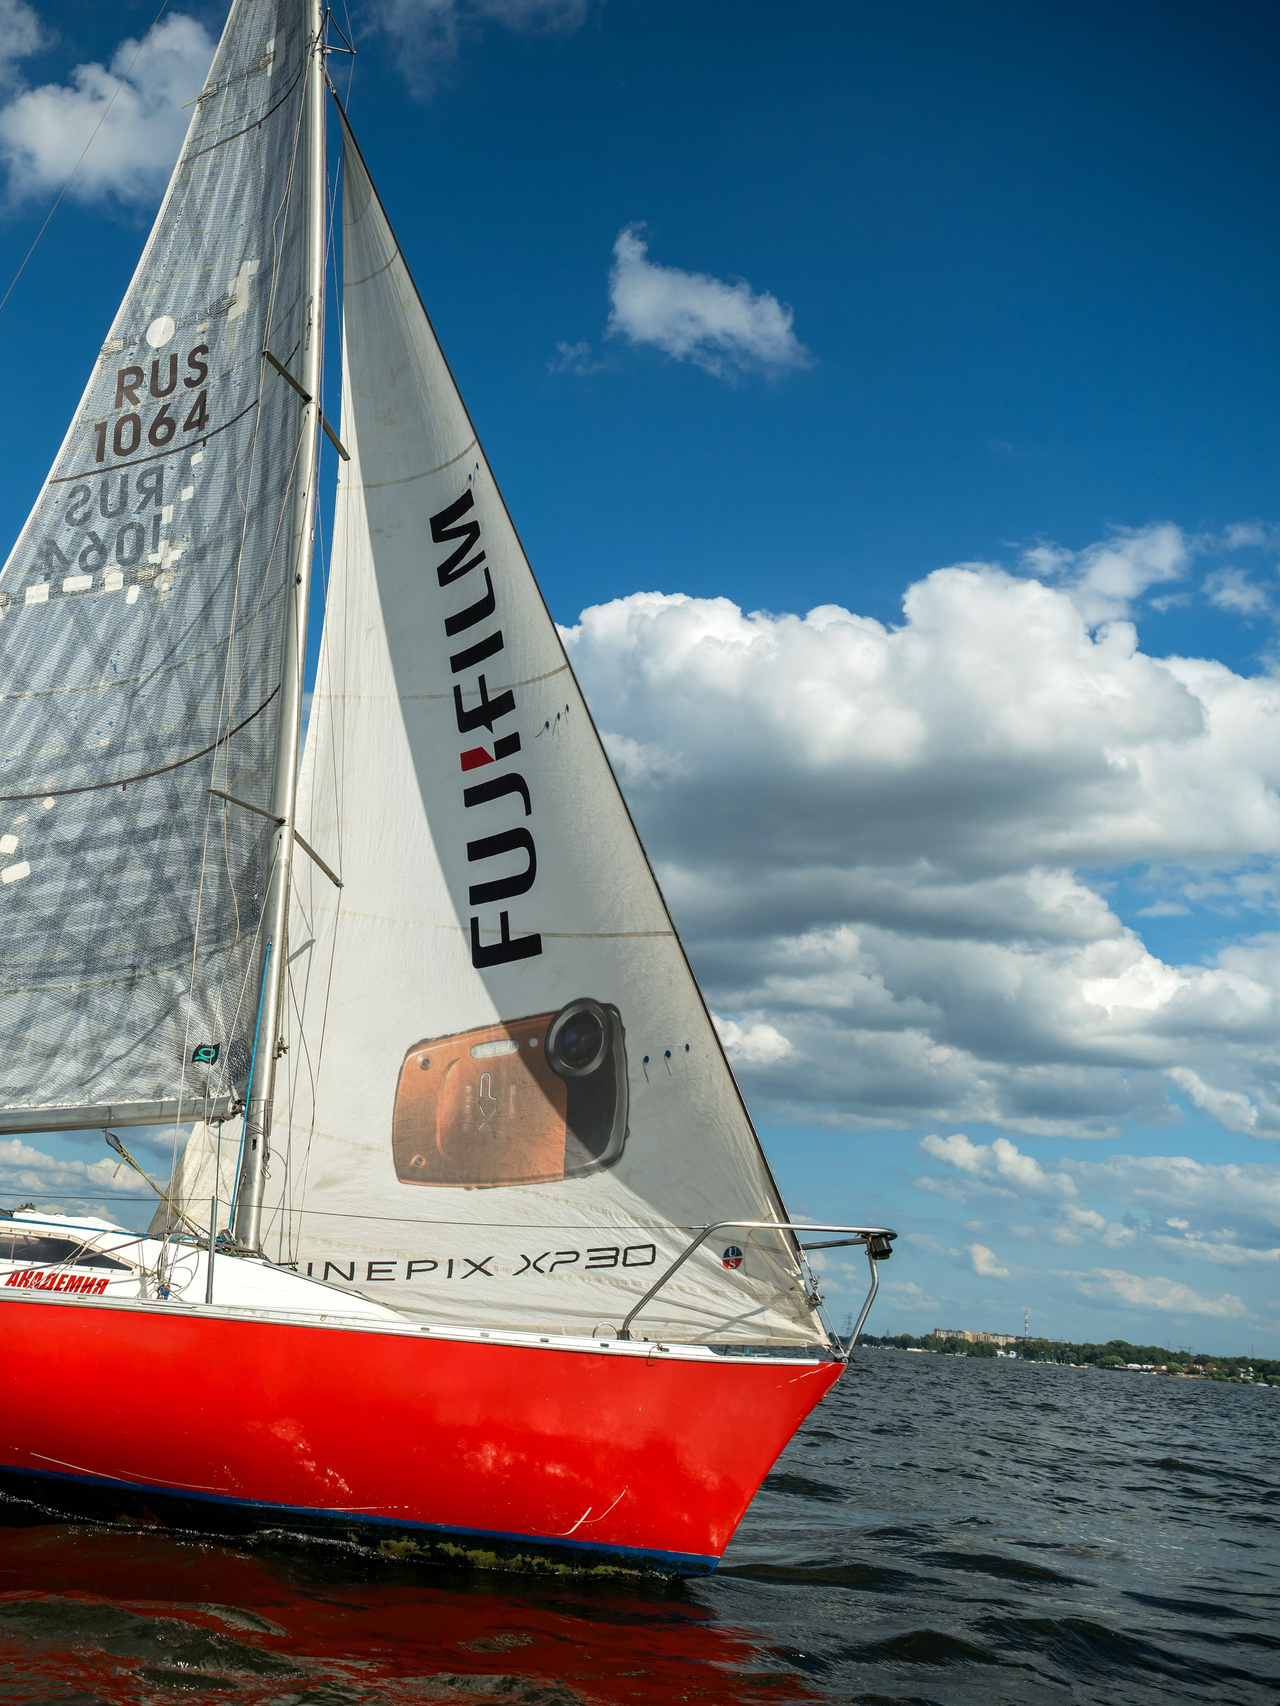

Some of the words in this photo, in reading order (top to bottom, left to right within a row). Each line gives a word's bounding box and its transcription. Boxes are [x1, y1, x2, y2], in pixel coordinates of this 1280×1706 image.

[114, 344, 210, 409] RUS
[94, 389, 210, 463] 1064
[429, 488, 543, 969] FUJIFILM
[5, 1269, 110, 1295] АКАДЕМИЯ
[274, 1256, 495, 1282] INEPIX
[512, 1243, 657, 1276] XP30
